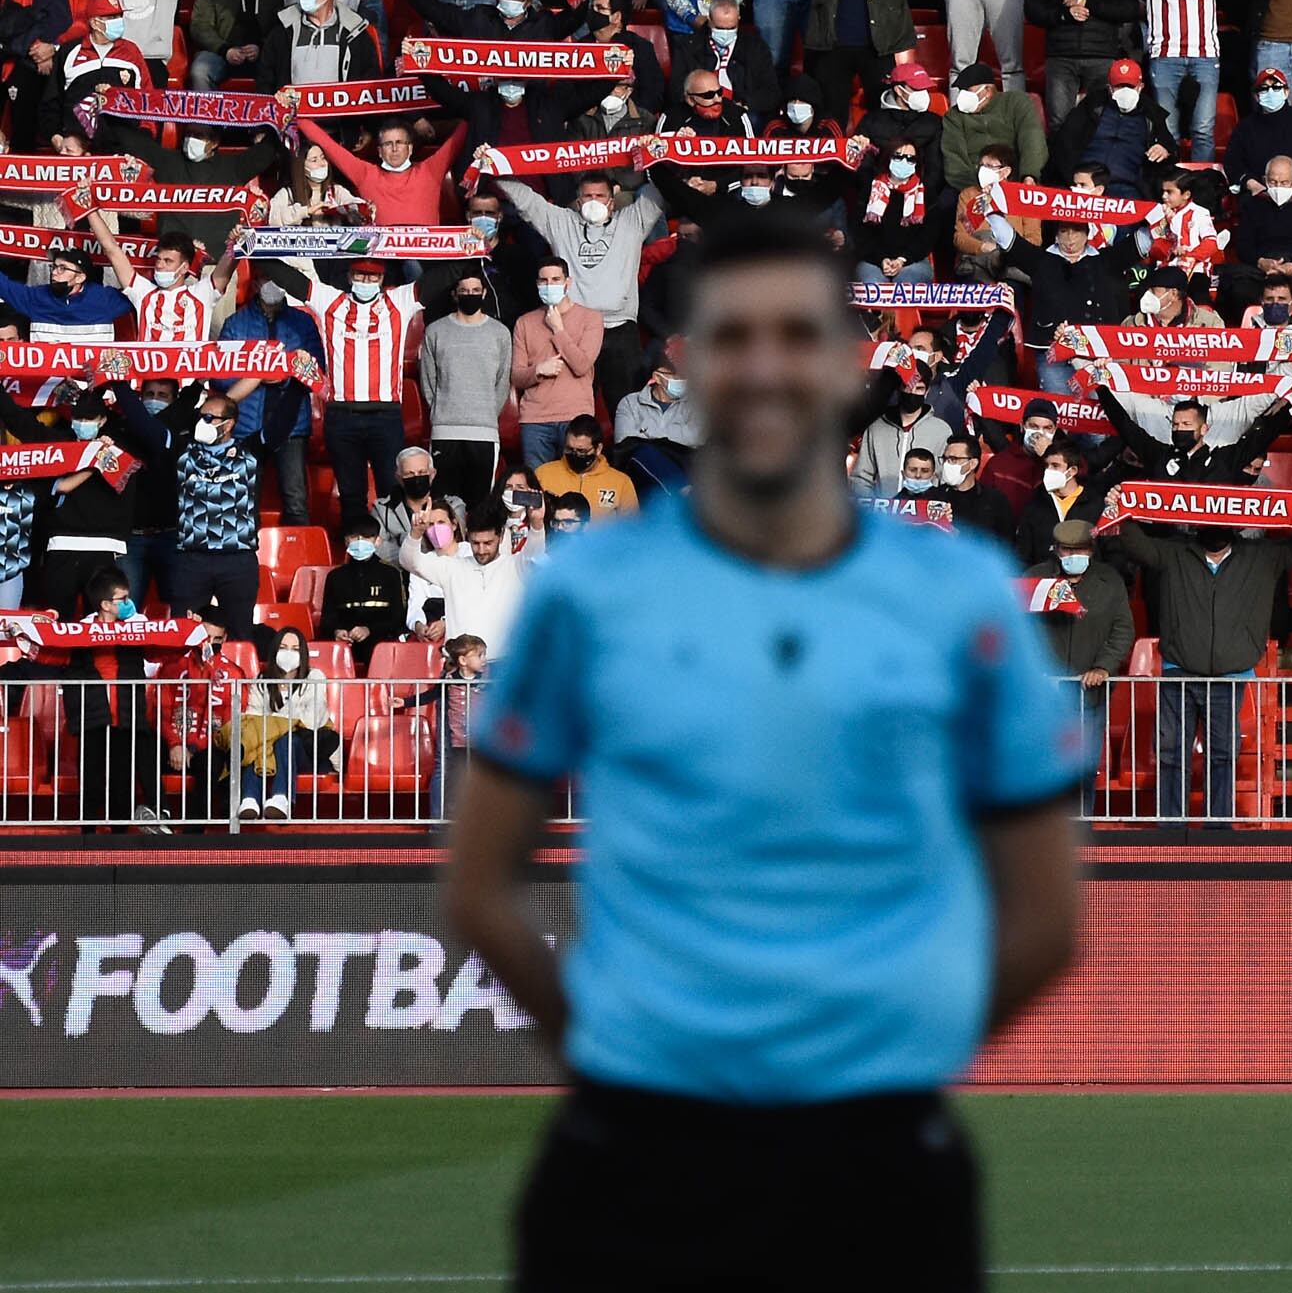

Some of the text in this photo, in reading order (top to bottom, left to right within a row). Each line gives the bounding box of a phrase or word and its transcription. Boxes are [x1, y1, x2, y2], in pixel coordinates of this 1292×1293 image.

[437, 47, 594, 69] U.D.ALMERÍA
[385, 235, 456, 250] ALMERIA
[1119, 330, 1243, 349] UD ALMERÍA
[131, 351, 169, 371] UD
[1155, 347, 1208, 357] 2001-2021
[1121, 491, 1288, 517] U.D.ALMERÍA
[63, 929, 541, 1038] FOOTBA
